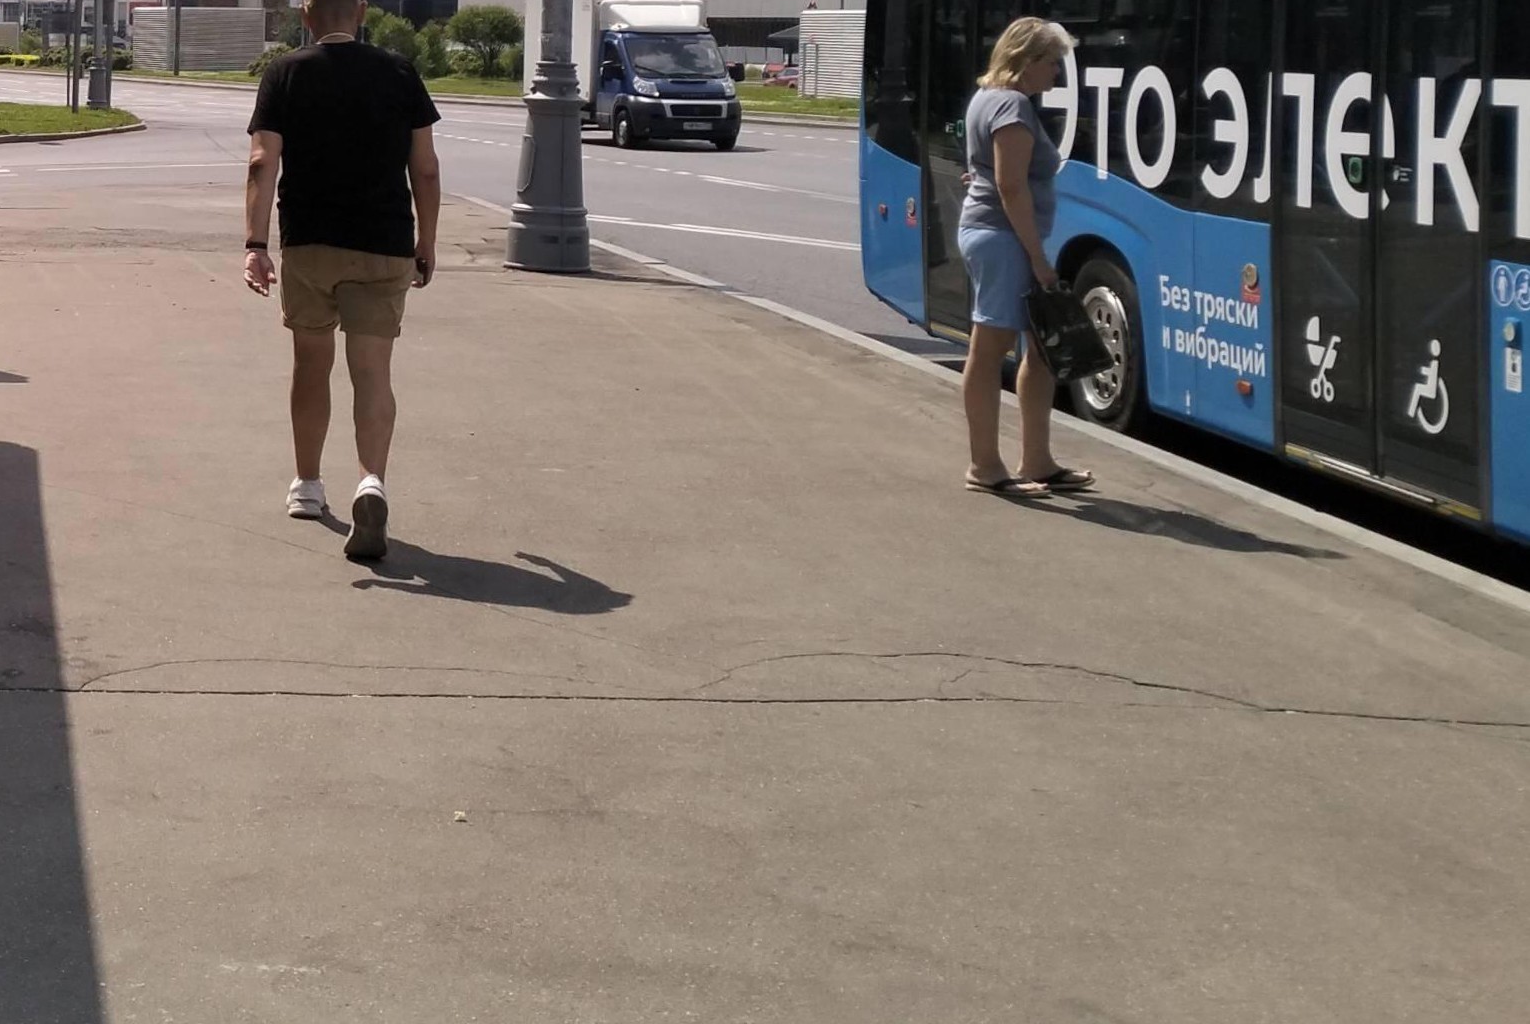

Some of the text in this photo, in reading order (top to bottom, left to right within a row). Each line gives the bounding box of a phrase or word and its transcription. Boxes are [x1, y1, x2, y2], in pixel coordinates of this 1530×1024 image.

[1158, 274, 1191, 312] Без
[1194, 290, 1259, 330] тряски
[1162, 325, 1266, 377] и вибраций
